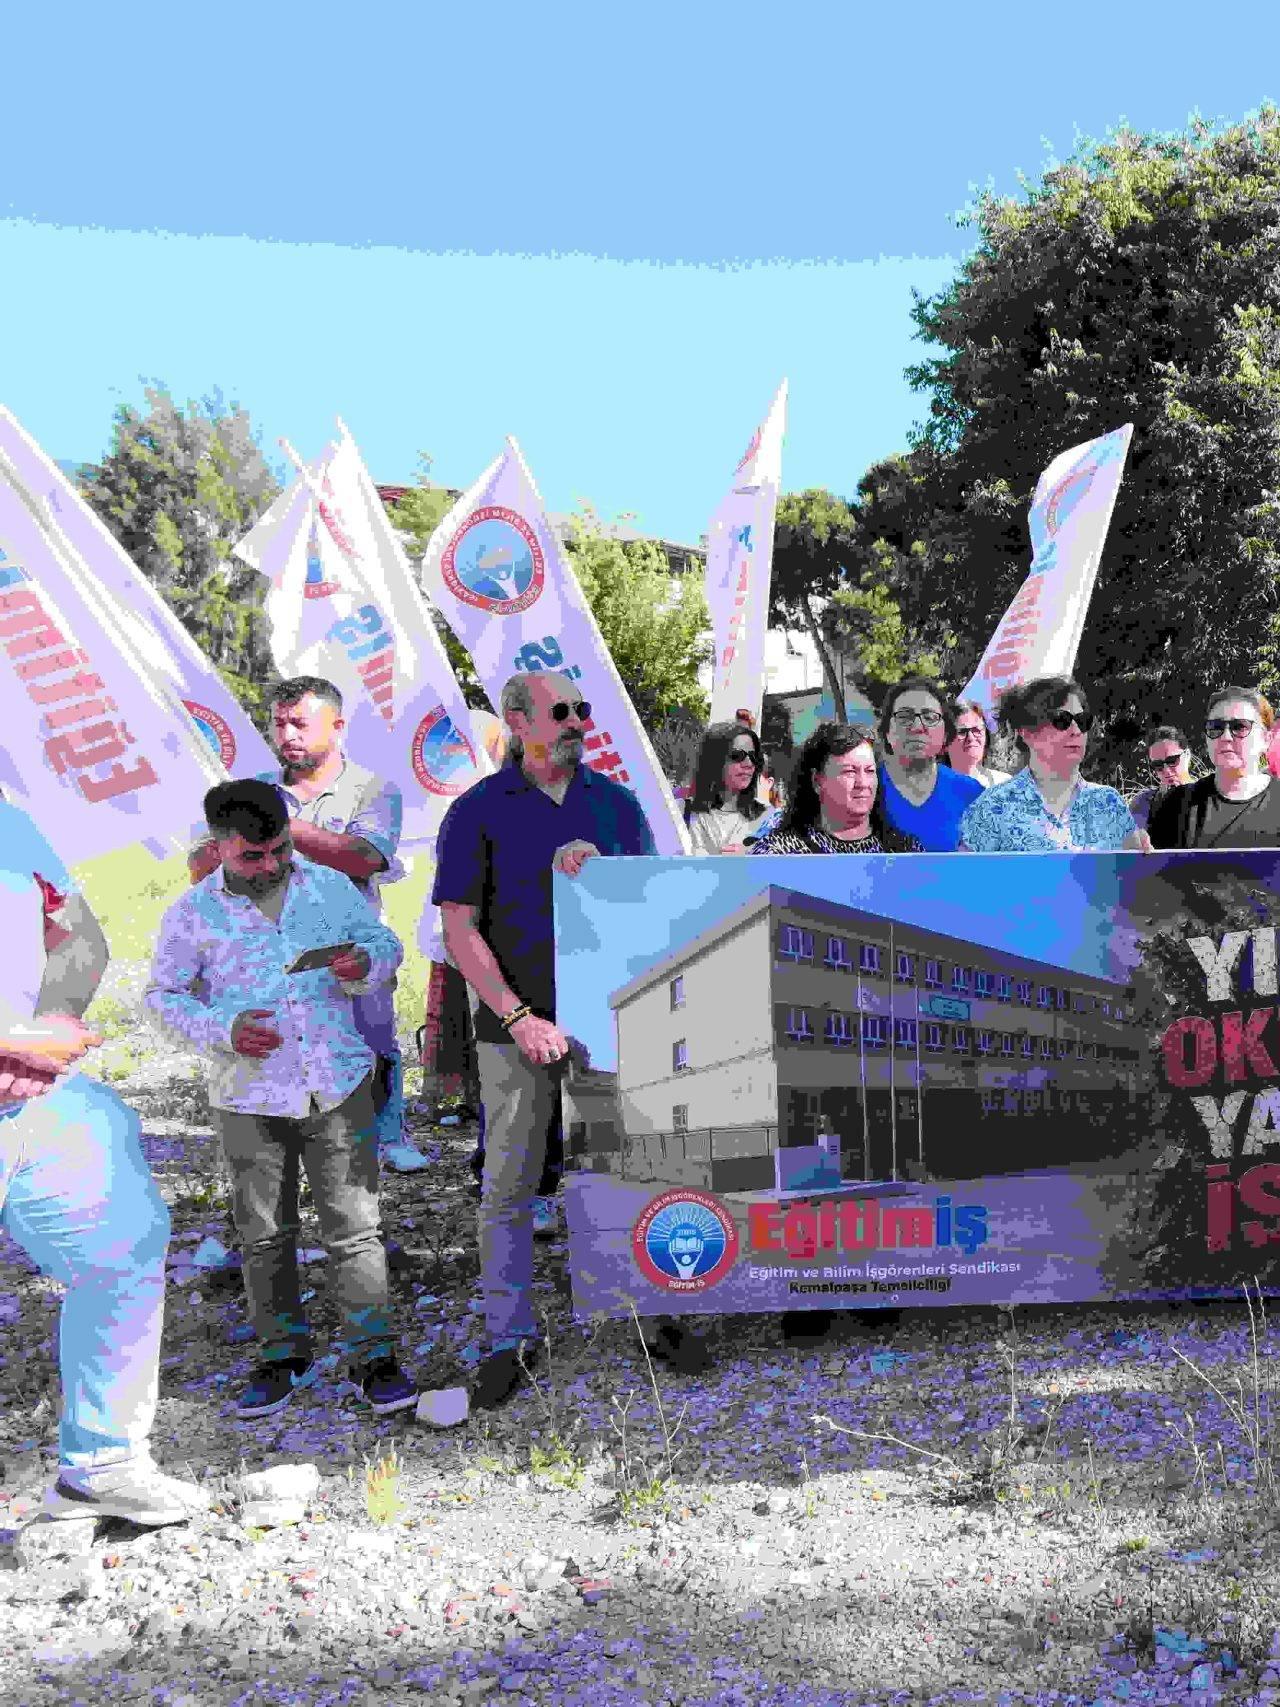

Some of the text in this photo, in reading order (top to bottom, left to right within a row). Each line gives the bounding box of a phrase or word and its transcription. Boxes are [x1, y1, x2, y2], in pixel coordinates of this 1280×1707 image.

[749, 1261, 1021, 1281] Eğitim ve Bilim İşgörenleri Sendikası
